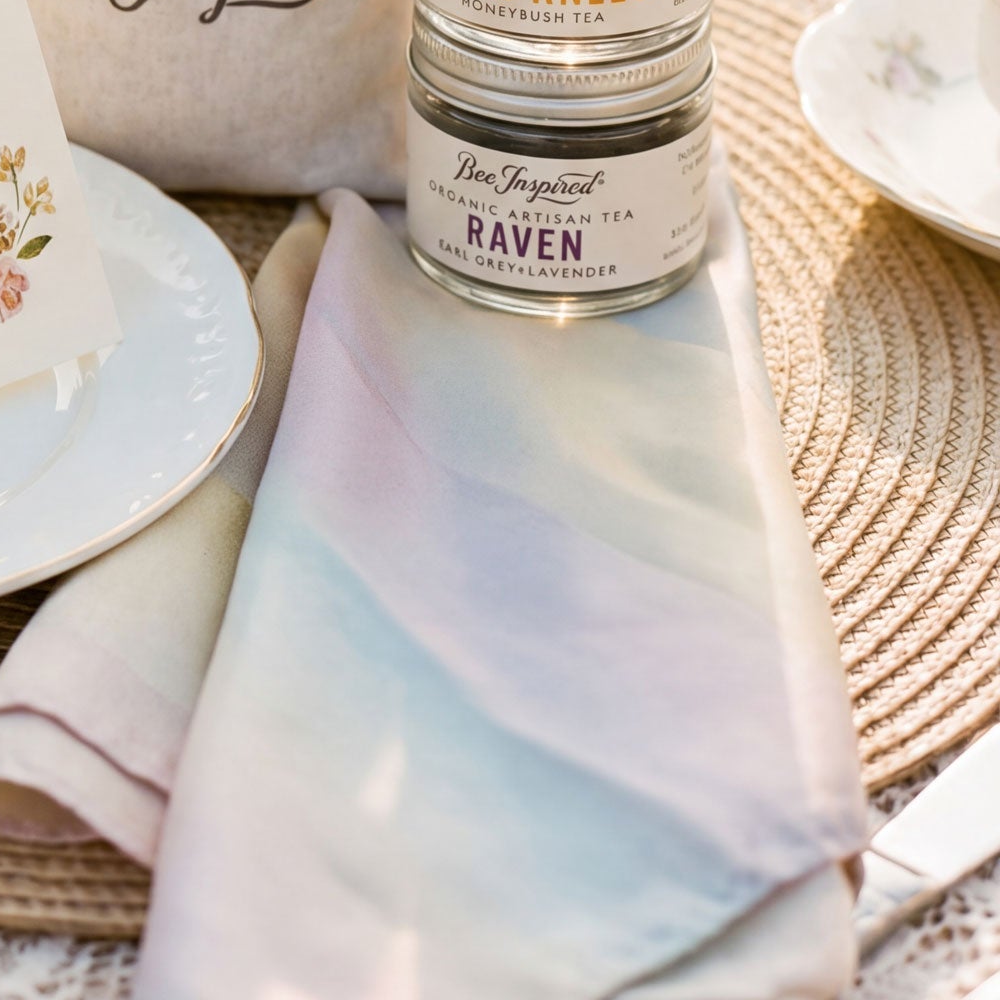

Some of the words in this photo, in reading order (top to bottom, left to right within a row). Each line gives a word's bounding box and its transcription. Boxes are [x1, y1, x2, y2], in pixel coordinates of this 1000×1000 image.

[573, 12, 605, 24] TEA
[453, 150, 497, 185] Bee
[508, 209, 592, 224] ARTISAN
[602, 209, 634, 223] TEA
[467, 214, 582, 261] RAVEN
[438, 238, 469, 262] EARL
